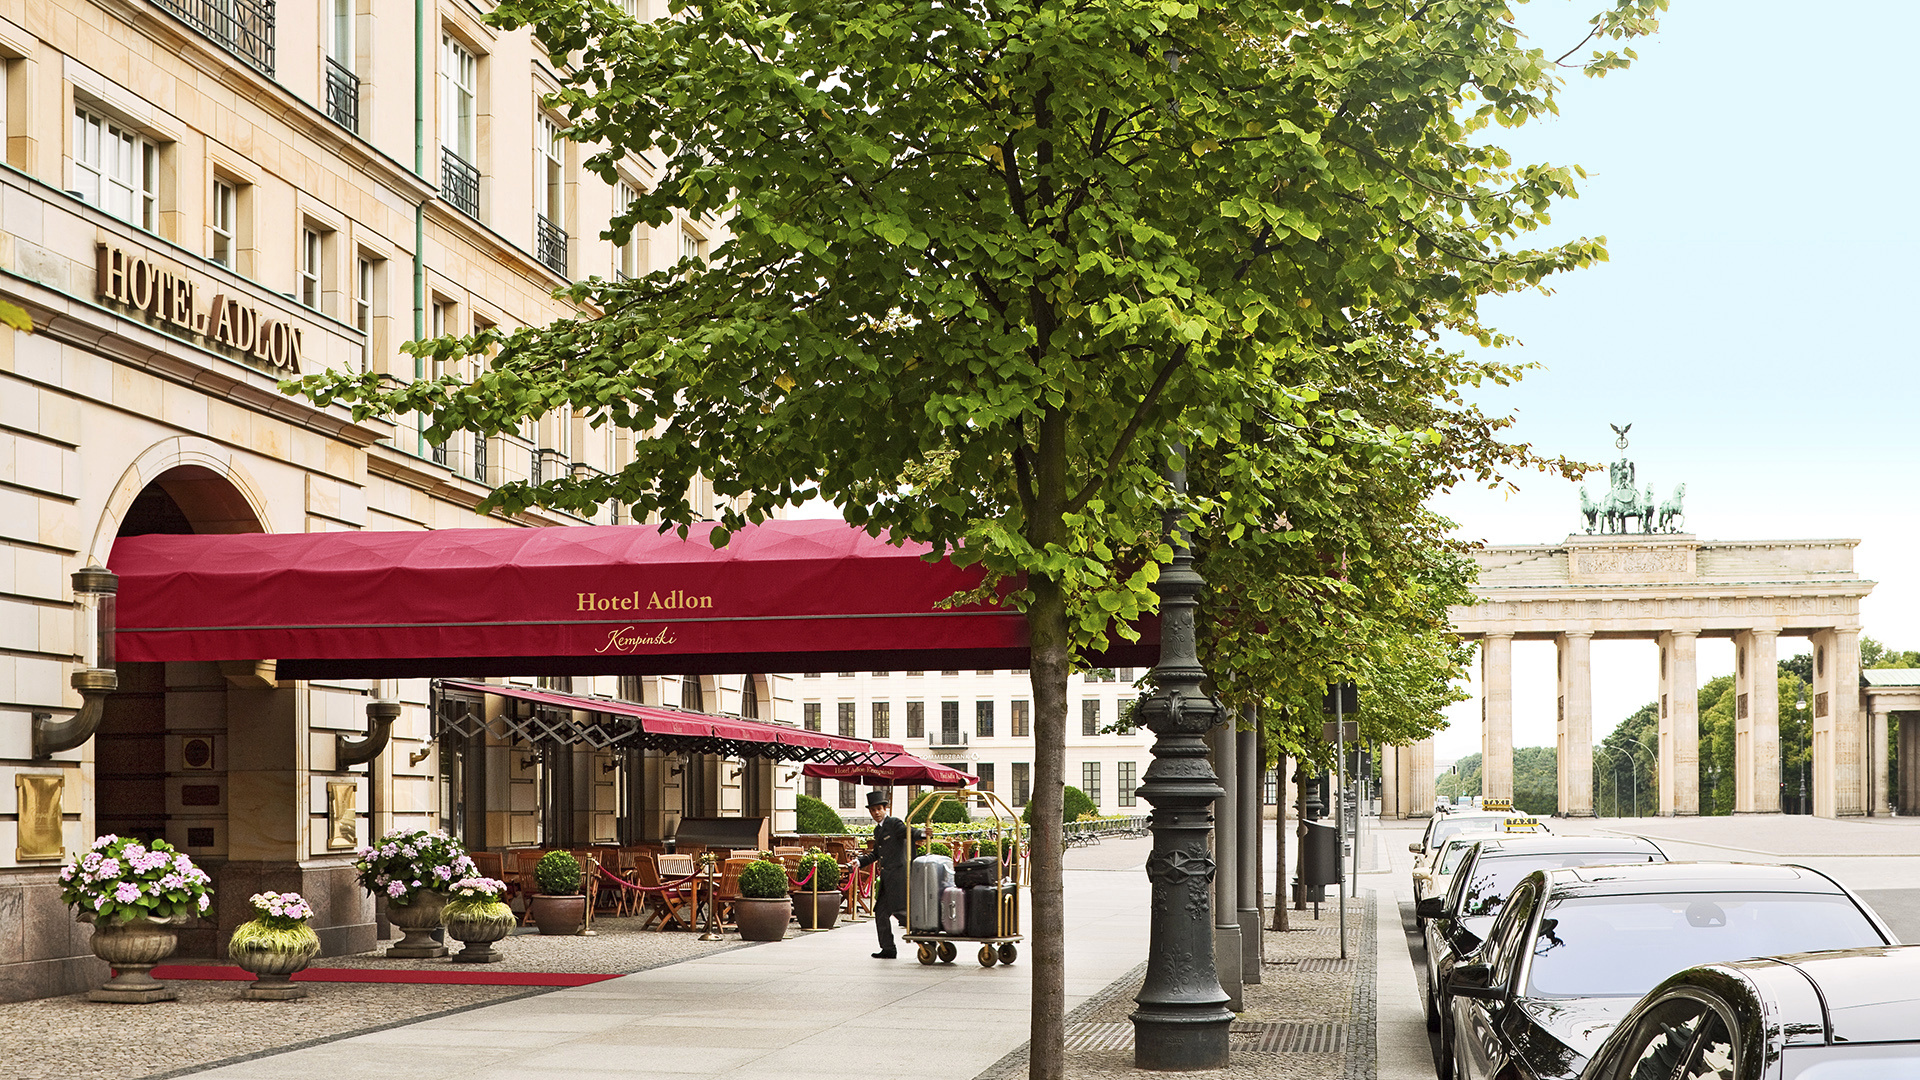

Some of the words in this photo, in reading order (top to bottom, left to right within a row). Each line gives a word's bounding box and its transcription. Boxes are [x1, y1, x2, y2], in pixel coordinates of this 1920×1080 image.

[100, 242, 209, 336] HOTEL
[213, 294, 304, 376] ADLON
[576, 590, 640, 612] Hotel
[646, 589, 714, 611] Adlon
[594, 625, 677, 654] Kempinski
